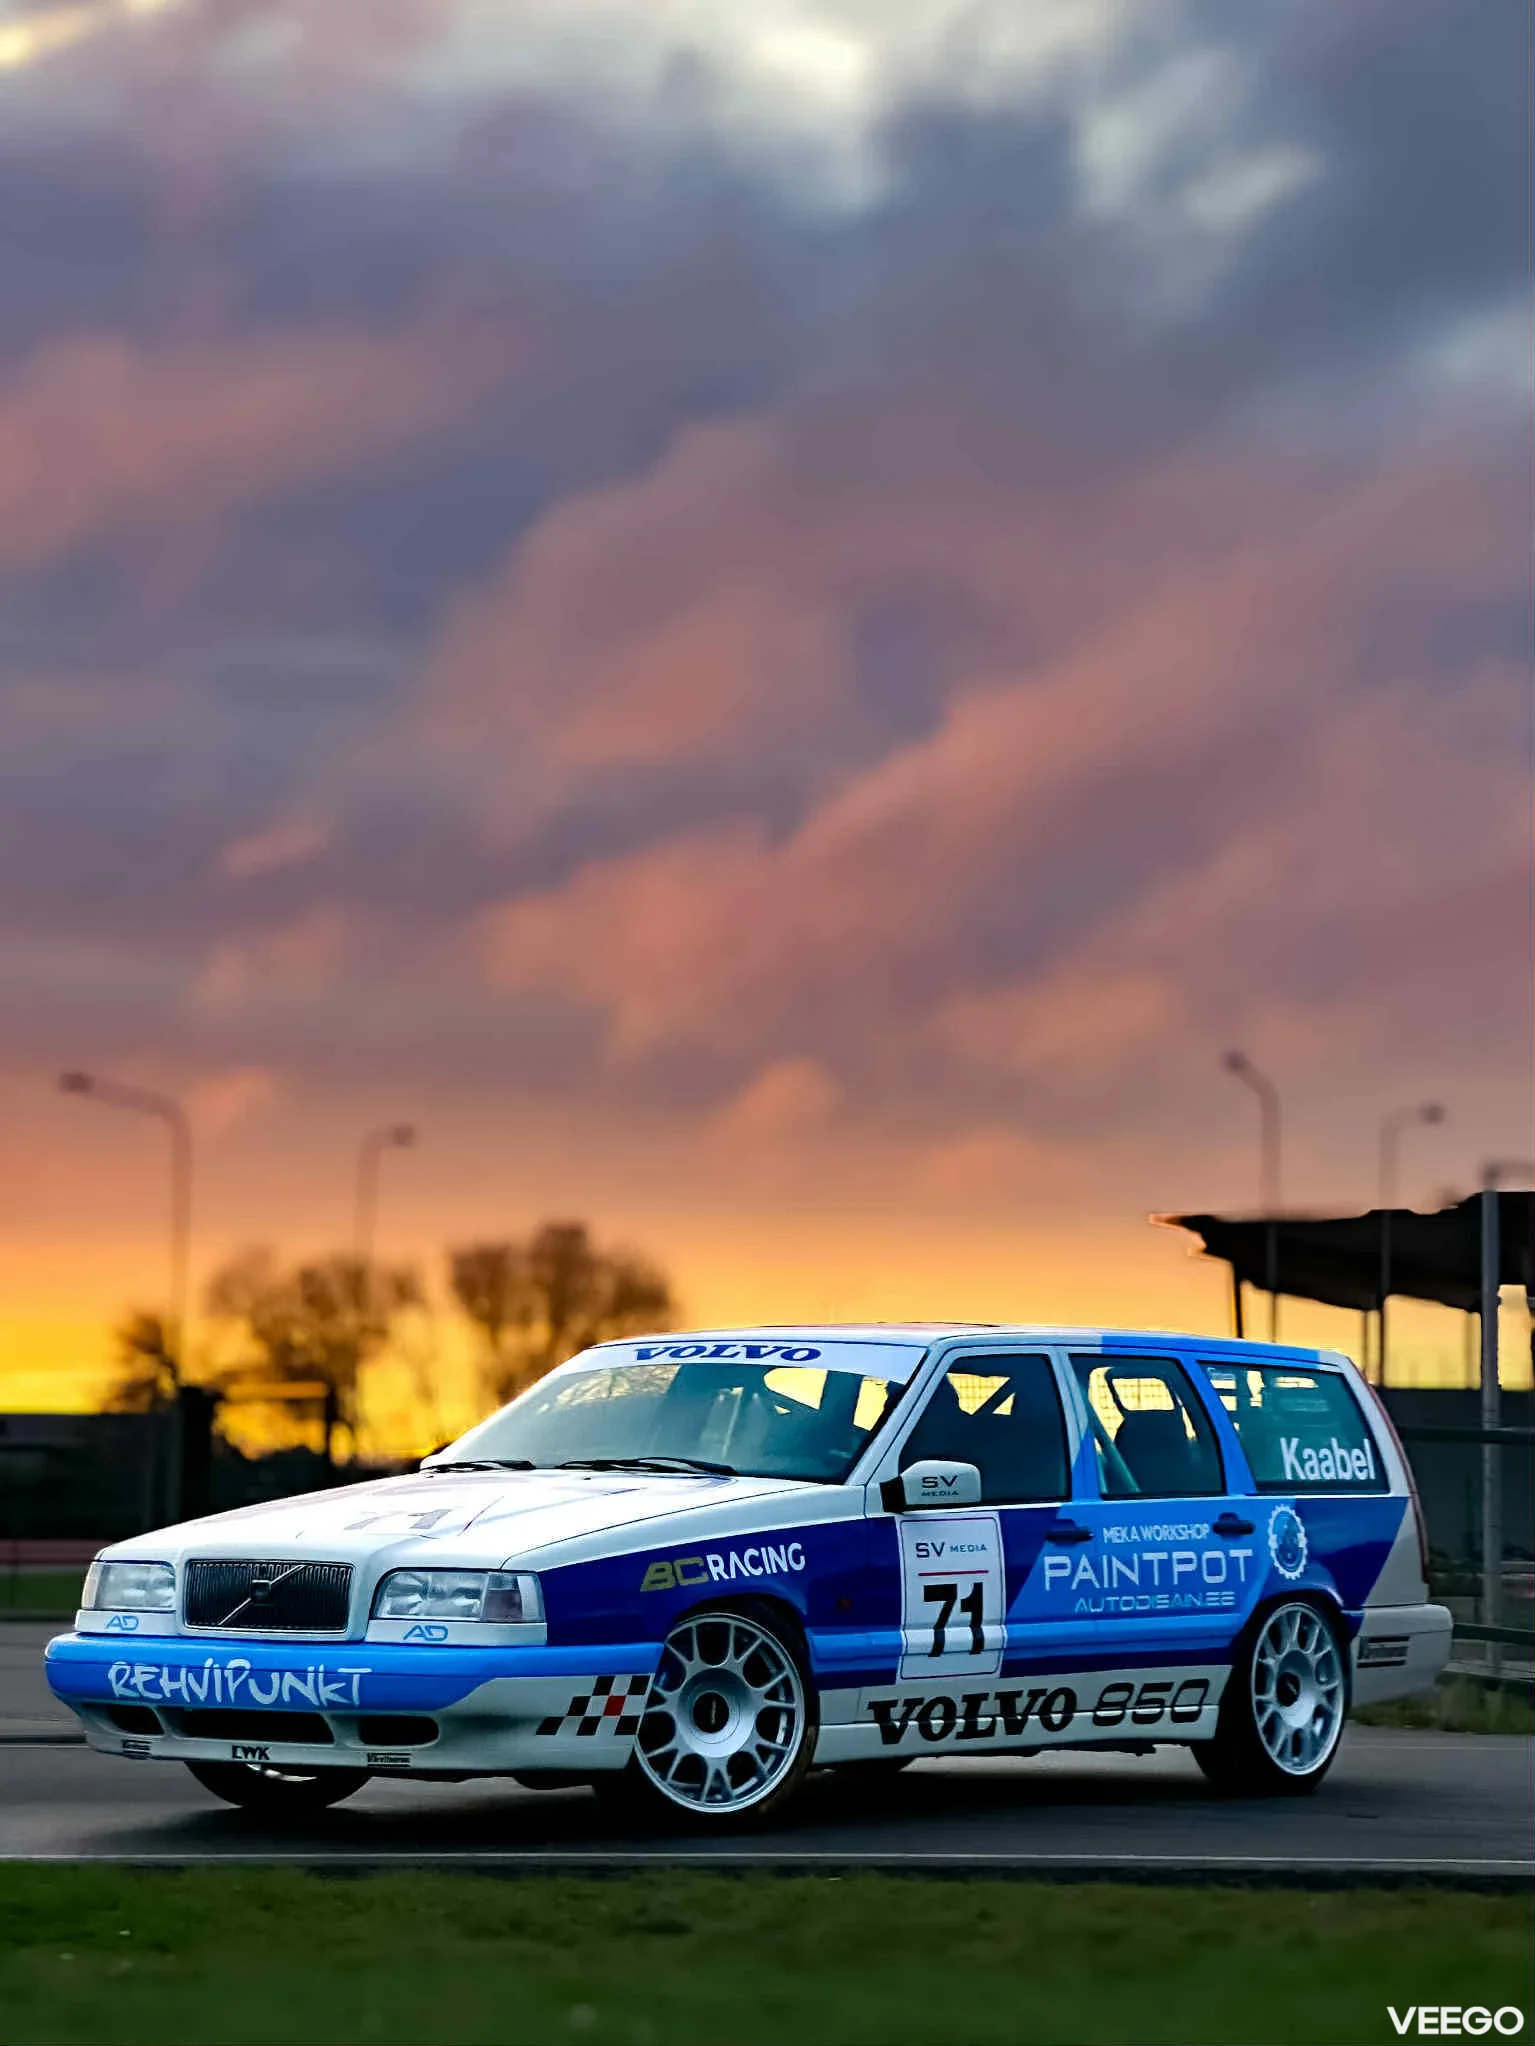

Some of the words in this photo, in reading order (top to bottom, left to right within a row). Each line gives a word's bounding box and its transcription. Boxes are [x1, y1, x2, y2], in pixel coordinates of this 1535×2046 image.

[635, 1344, 822, 1362] VOLVO
[1280, 1437, 1376, 1480] Kaabel
[921, 1475, 958, 1488] SV
[915, 1541, 945, 1559] SV
[950, 1543, 988, 1553] MEDIA
[1103, 1525, 1141, 1544] MEKA
[1140, 1523, 1210, 1542] WORKSHOP
[706, 1542, 806, 1582] RACING
[1044, 1549, 1253, 1591] PAINTPOT
[923, 1581, 985, 1658] 71
[867, 1687, 1078, 1745] VOLVO
[1092, 1678, 1211, 1727] 850
